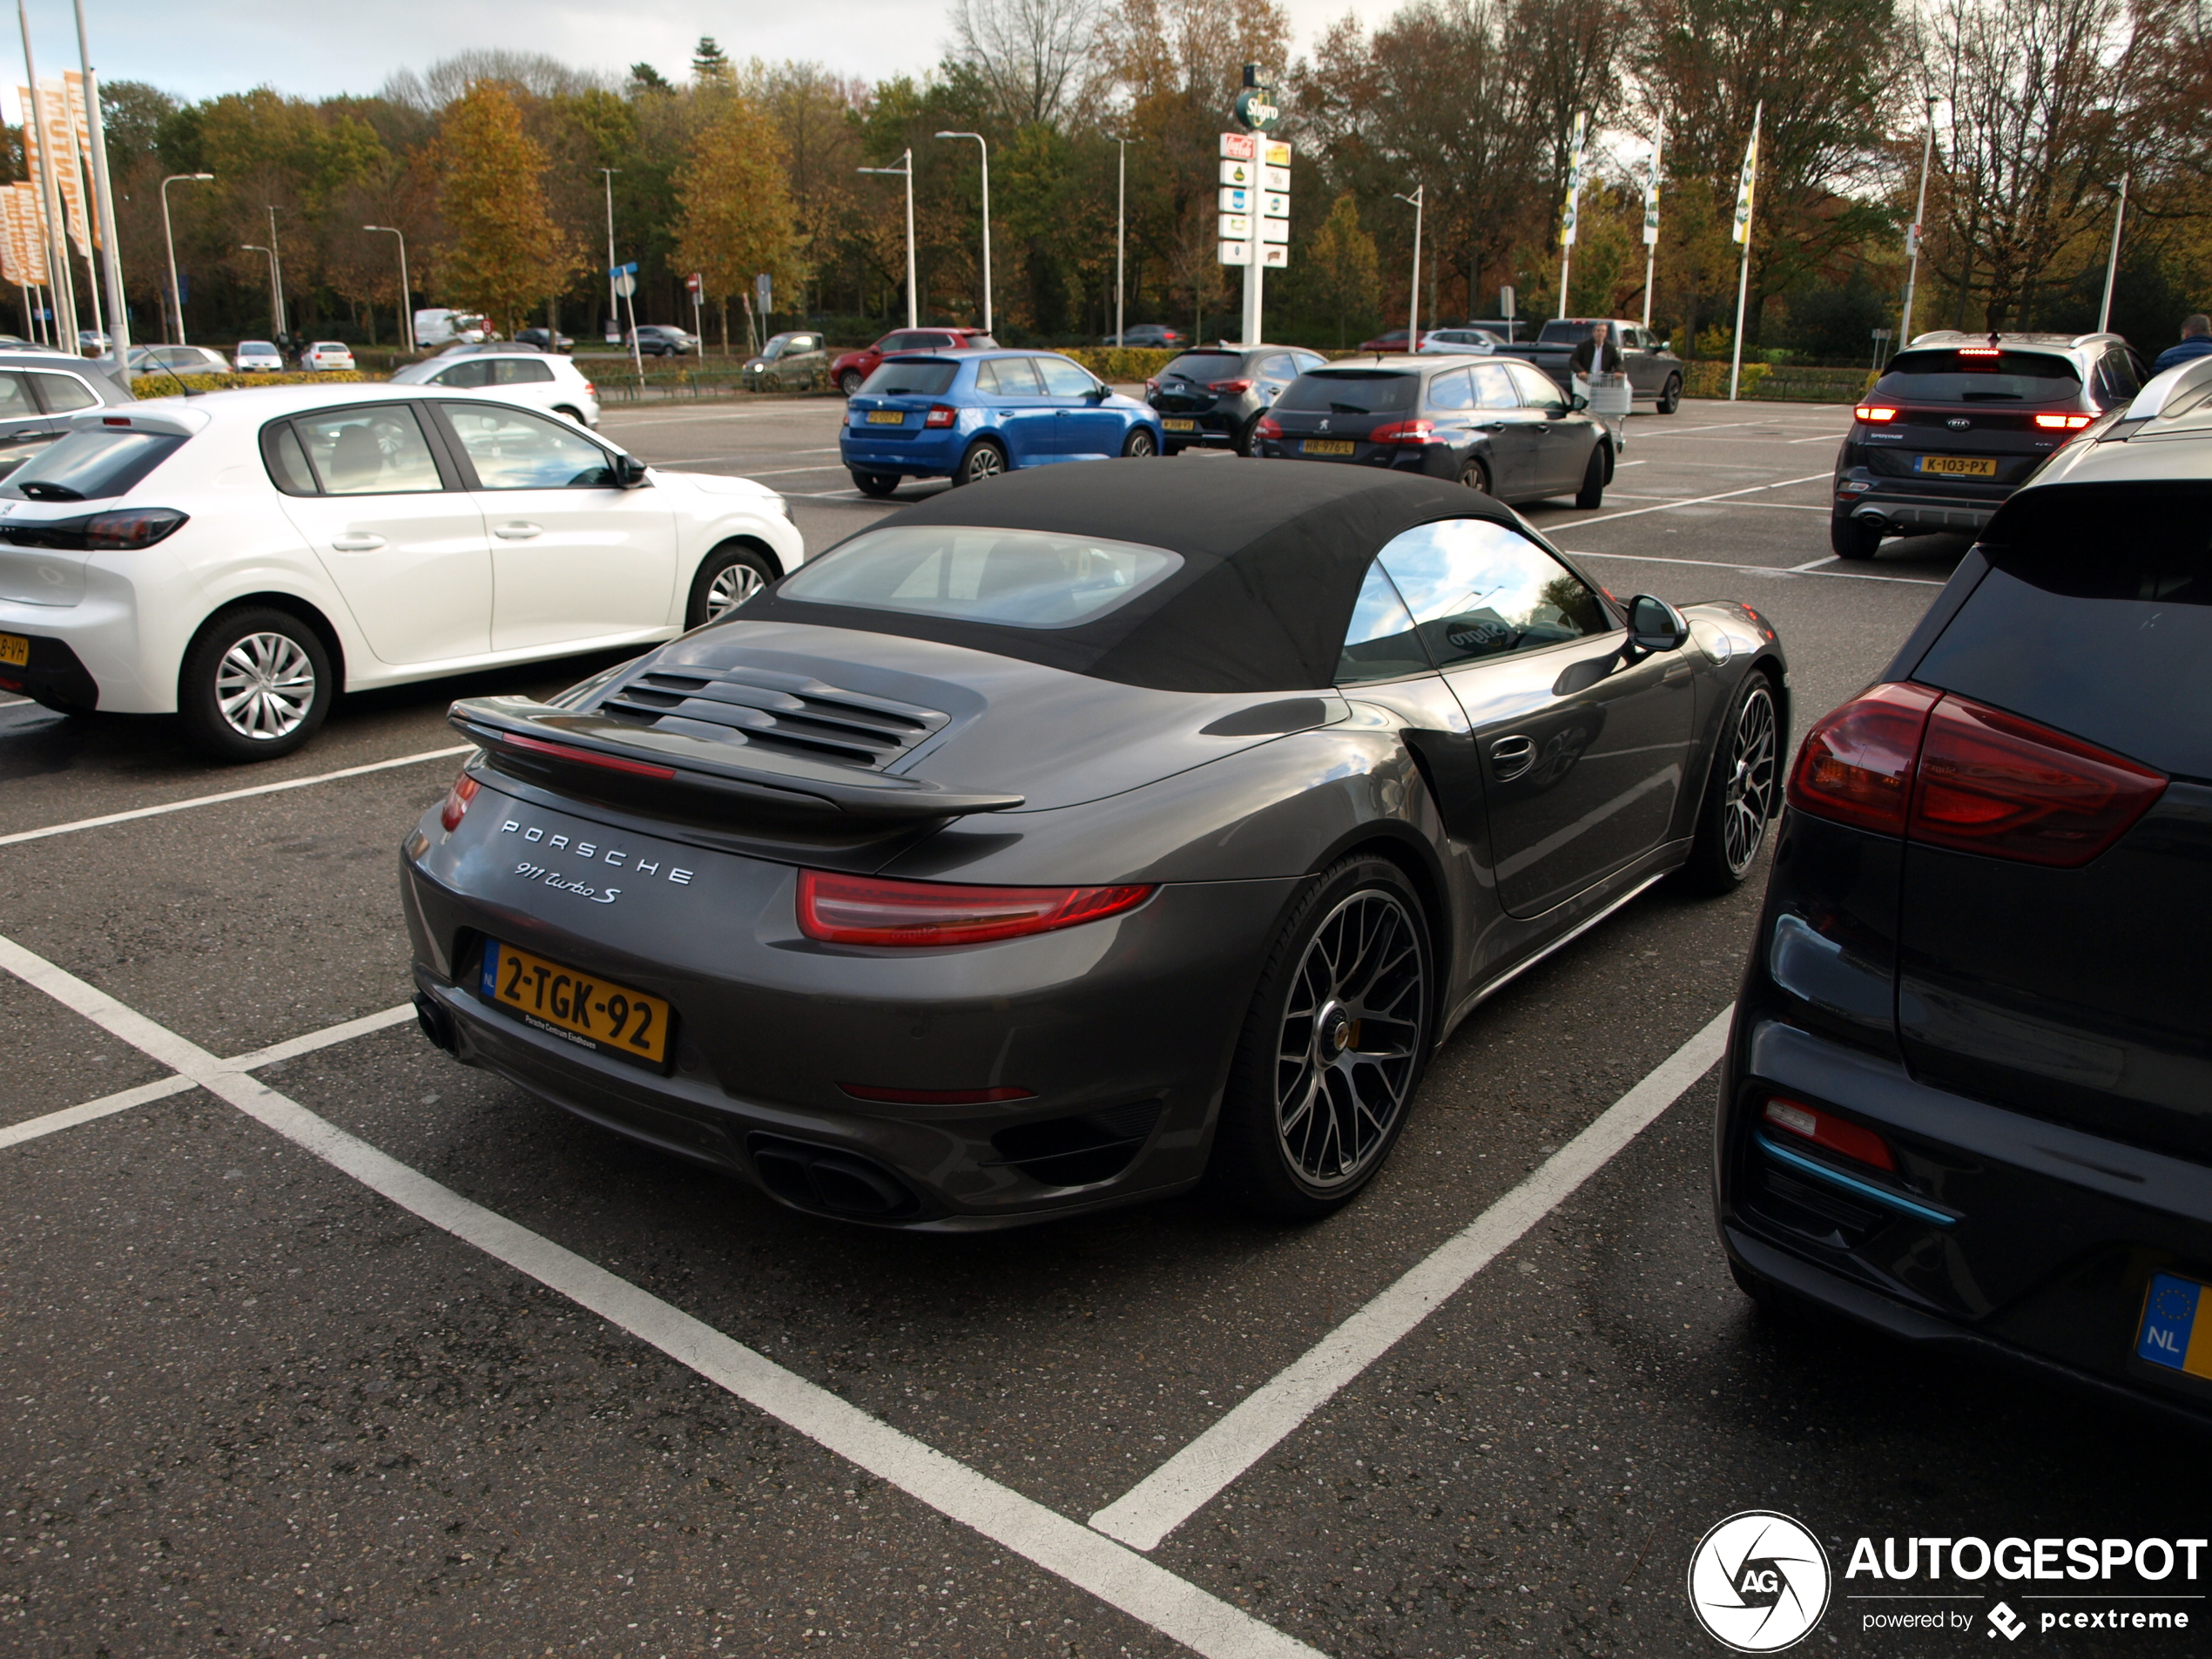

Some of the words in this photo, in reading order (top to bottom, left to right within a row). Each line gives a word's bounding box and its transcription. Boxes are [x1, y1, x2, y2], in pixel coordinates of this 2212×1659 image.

[1247, 98, 1278, 122] Sligro
[1950, 420, 1968, 428] KIA
[1306, 442, 1350, 453] HR-976-L
[1927, 459, 1989, 474] K-103-PX
[0, 638, 26, 662] 8-VH
[502, 819, 694, 885] PORSCHE
[515, 862, 546, 880] 911
[545, 873, 596, 897] turbo
[590, 887, 623, 904] S
[483, 973, 495, 988] NL
[503, 955, 653, 1050] 2-TGK-92
[525, 1014, 545, 1030] Porsche
[545, 1022, 568, 1039] Centrum
[568, 1031, 597, 1050] Eindhoven
[2147, 1325, 2180, 1353] NL
